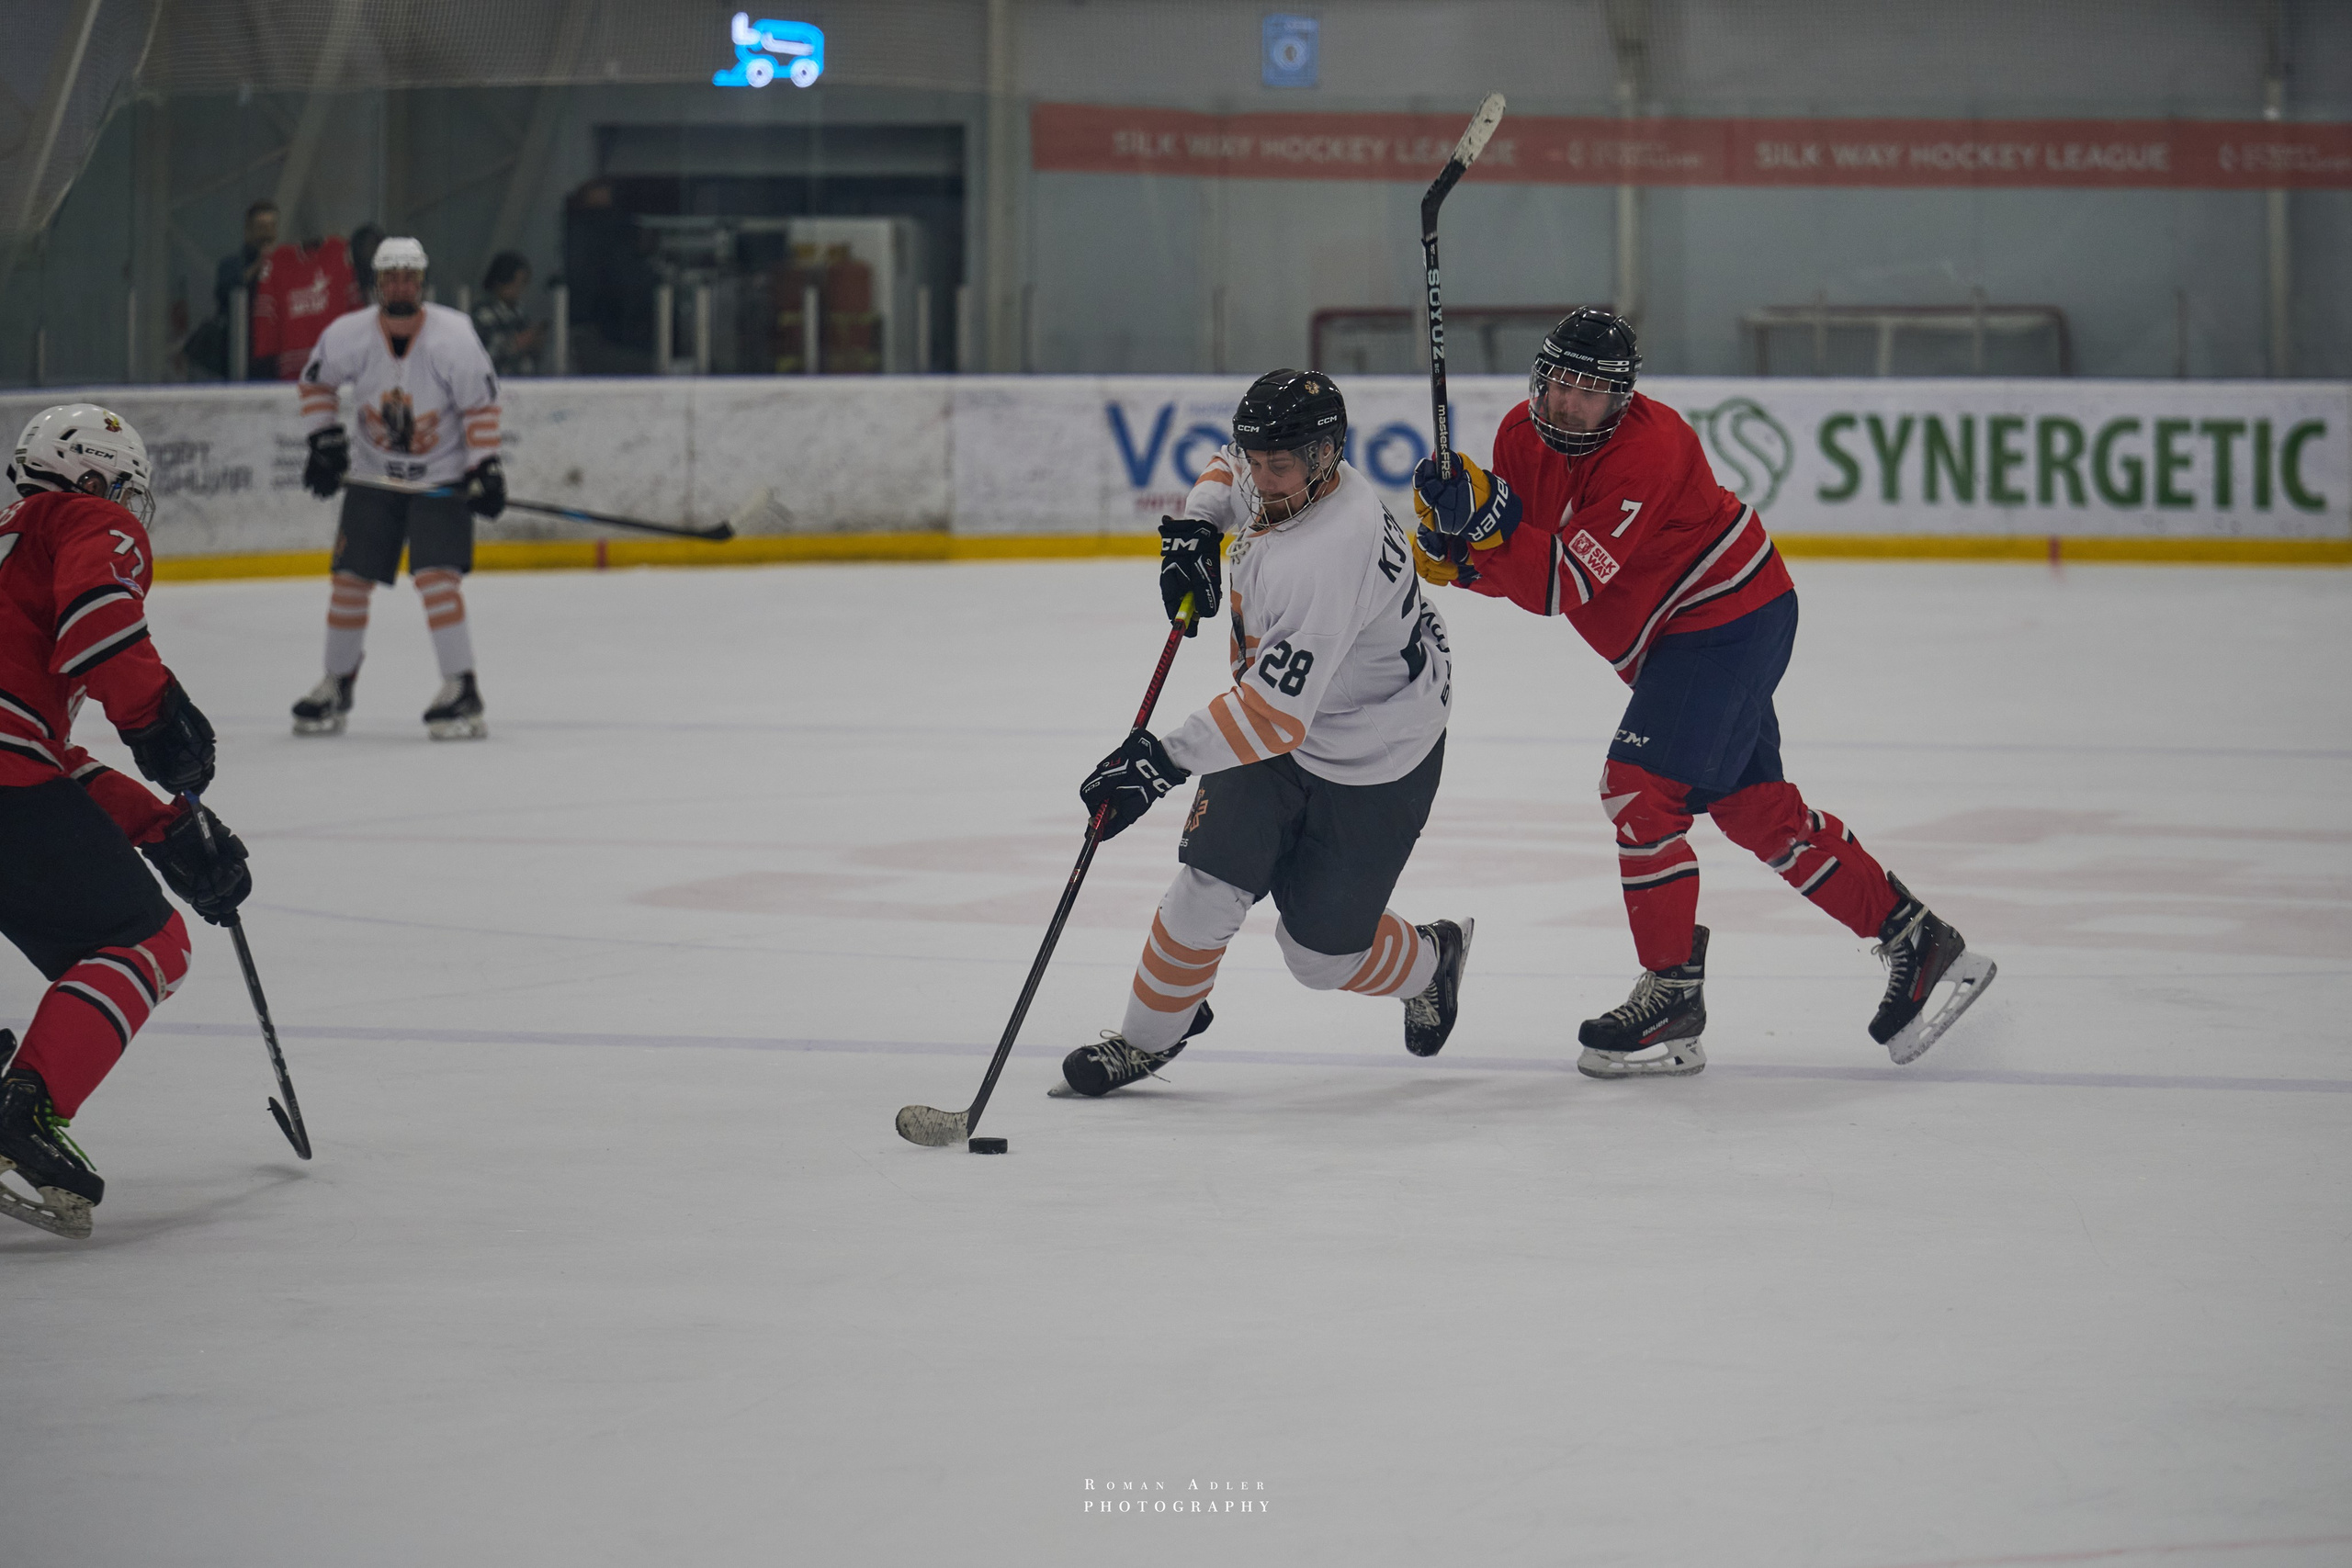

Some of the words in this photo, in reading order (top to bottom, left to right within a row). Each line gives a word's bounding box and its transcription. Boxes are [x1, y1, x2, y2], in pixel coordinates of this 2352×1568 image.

[1260, 136, 1387, 163] HOCKEY
[1395, 138, 1516, 166] LEAUE
[1754, 141, 1820, 169] SILK
[1828, 142, 1904, 169] WAY
[1909, 142, 2041, 170] HOCKEY
[2045, 143, 2171, 172] LEAGUE
[1428, 267, 1444, 359] SOYUZ
[1563, 350, 1595, 363] BAUER
[1237, 424, 1260, 433] CCM
[1317, 415, 1338, 426] CCM
[85, 447, 114, 460] CCM
[1817, 412, 2328, 512] SYNERGETIC
[1610, 499, 1643, 539] 7
[1161, 537, 1200, 551] CM
[1587, 555, 1610, 579] WAY
[1592, 548, 1616, 574] SILK
[1258, 640, 1315, 697] 28
[1614, 729, 1650, 748] CM
[1136, 758, 1172, 793] CC
